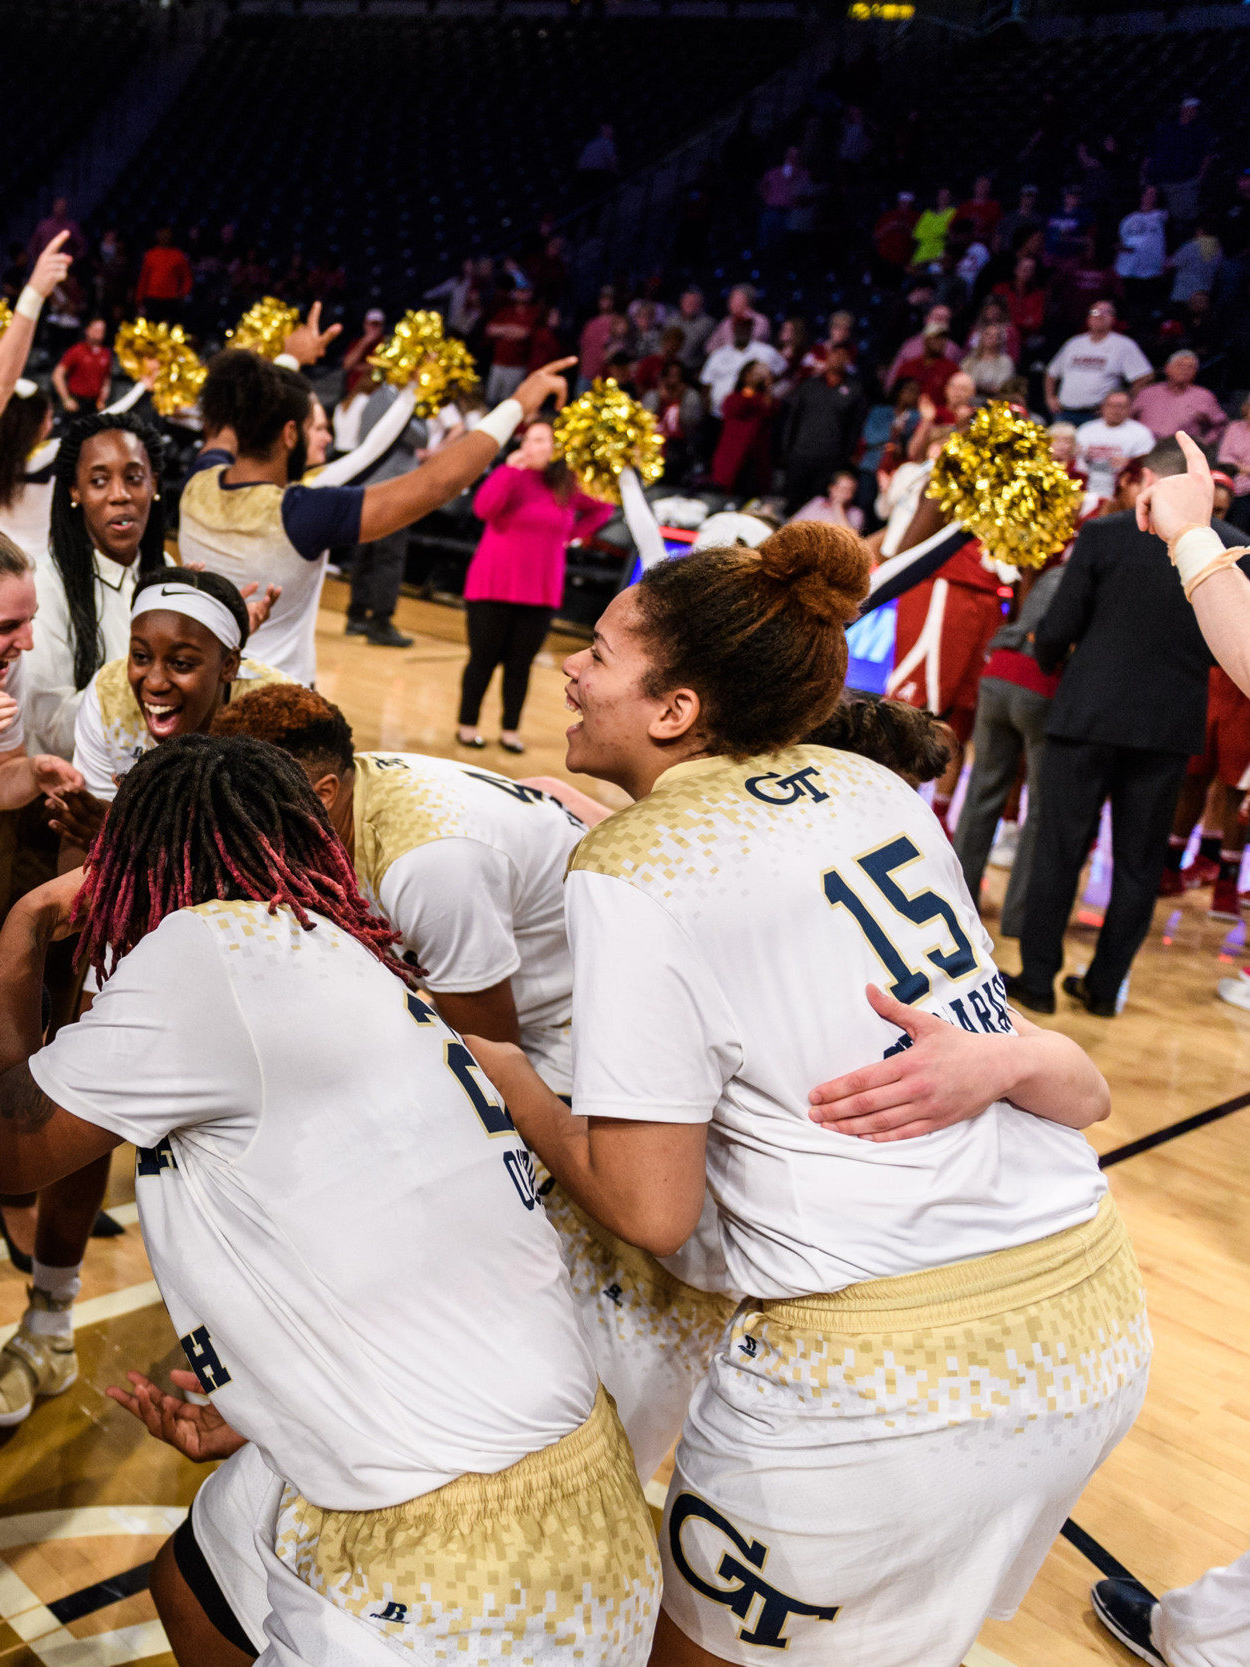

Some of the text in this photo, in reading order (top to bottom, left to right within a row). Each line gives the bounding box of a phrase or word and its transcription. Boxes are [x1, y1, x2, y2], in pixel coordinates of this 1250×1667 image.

[744, 766, 830, 806] GT
[820, 832, 982, 1006] 15
[669, 1490, 843, 1651] GT
